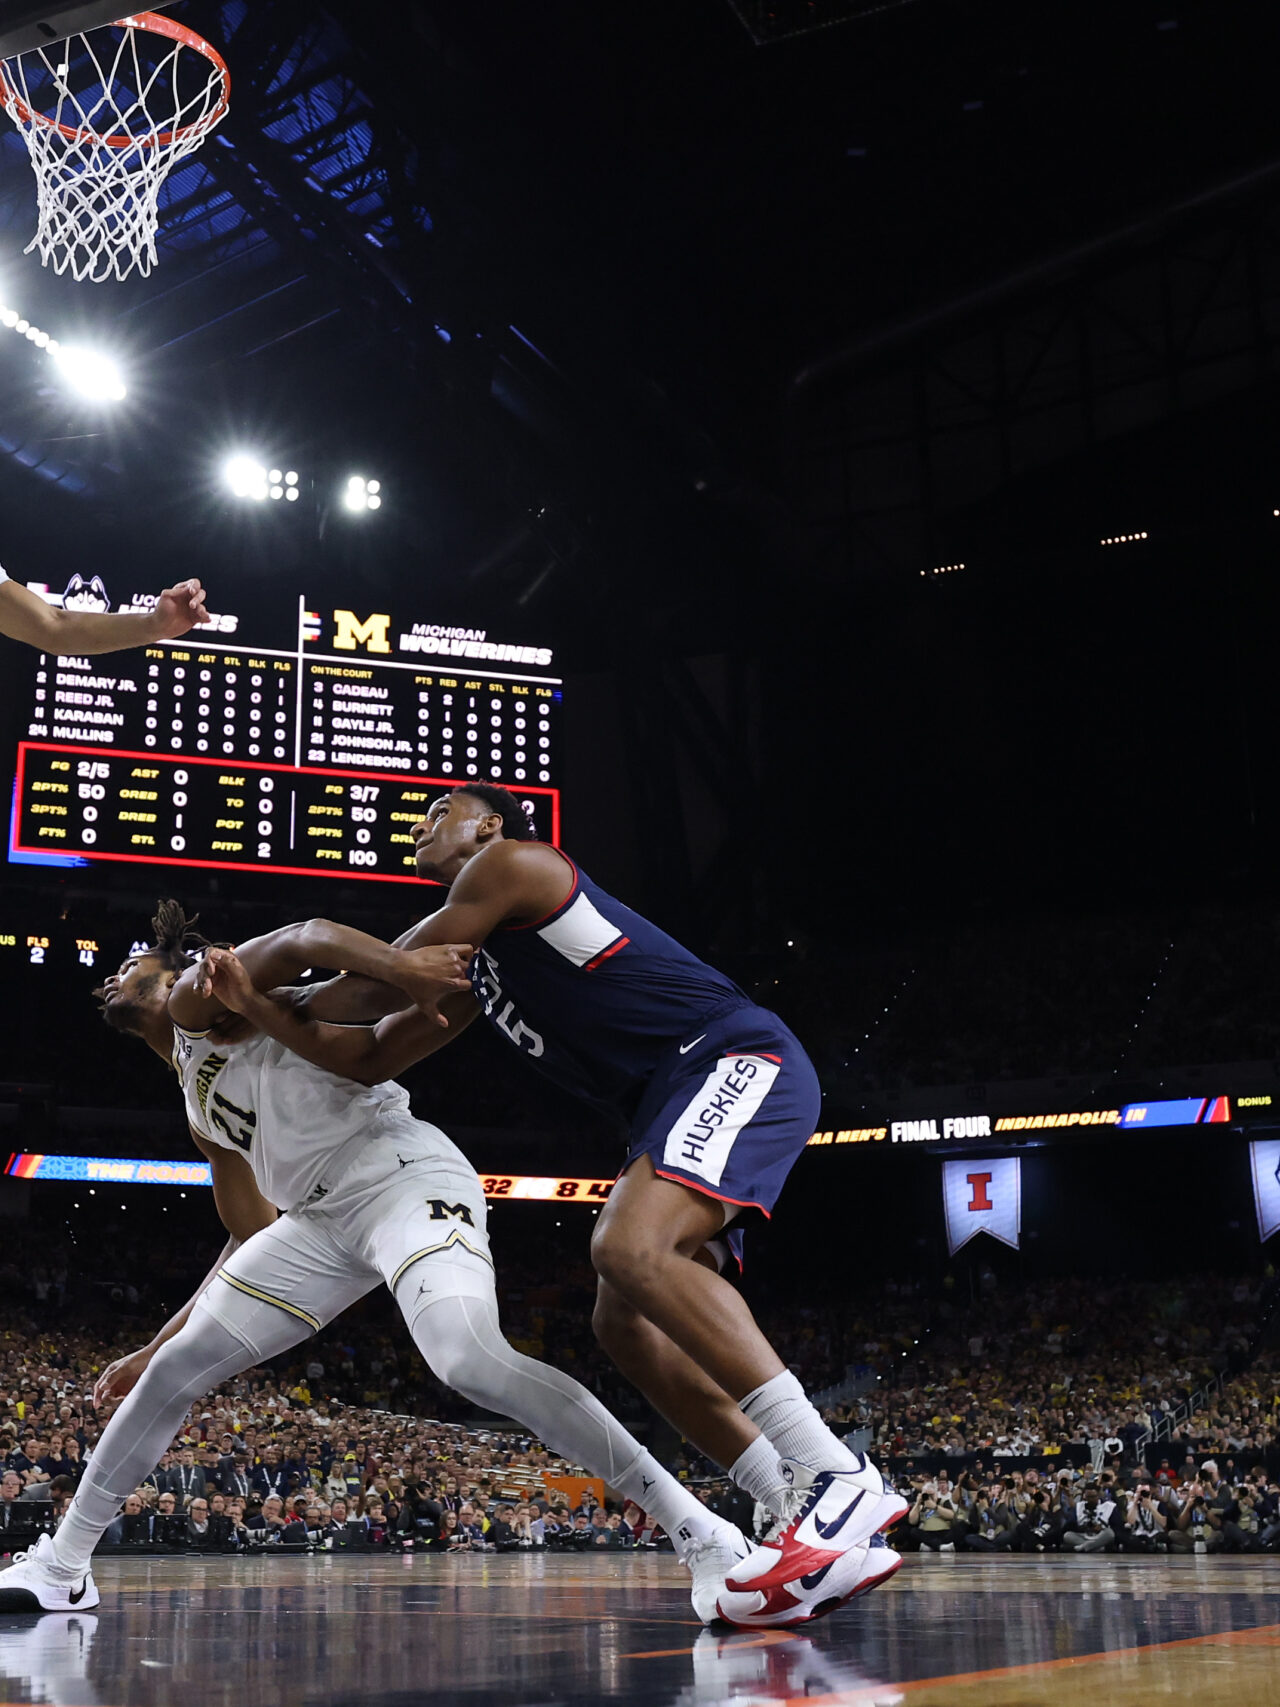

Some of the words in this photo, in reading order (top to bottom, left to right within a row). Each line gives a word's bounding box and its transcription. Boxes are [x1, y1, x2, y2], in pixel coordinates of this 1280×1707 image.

[333, 609, 392, 654] M
[412, 623, 486, 642] MICHIGAN
[146, 649, 163, 658] PTS
[172, 652, 190, 660] REB
[198, 655, 216, 663] AST
[224, 657, 240, 665] STL
[249, 659, 265, 668] BLK
[274, 662, 290, 671] FLS
[399, 634, 553, 666] WOLVERINES
[57, 656, 91, 670] BALL
[149, 665, 158, 676] 2
[174, 668, 185, 679] 0
[200, 670, 211, 681] 0
[279, 678, 284, 688] 1
[311, 665, 326, 675] ON
[325, 666, 342, 677] THE
[343, 667, 373, 679] COURT
[37, 672, 47, 683] 2
[56, 673, 116, 689] DEMARY
[118, 680, 137, 691] JR.
[148, 682, 158, 693] 0
[173, 685, 184, 696] 0
[199, 687, 210, 698] 0
[279, 695, 283, 705] 1
[314, 682, 323, 692] 3
[333, 684, 388, 699] CADEAU
[419, 692, 428, 703] 5
[443, 694, 452, 705] 2
[470, 697, 474, 707] 1
[415, 677, 432, 685] PTS
[440, 679, 457, 687] REB
[489, 684, 504, 692] STL
[512, 686, 528, 694] BLK
[536, 688, 552, 697] FLS
[36, 689, 45, 700] 5
[55, 691, 93, 705] REED
[147, 700, 157, 711] 2
[175, 703, 180, 713] 1
[199, 705, 209, 716] 0
[275, 712, 286, 723] 0
[313, 699, 323, 709] 4
[333, 701, 394, 716] BURNETT
[418, 709, 429, 720] 0
[445, 711, 450, 721] 1
[467, 713, 477, 724] 0
[35, 707, 44, 718] 11
[54, 708, 123, 725] KARABAN
[146, 717, 157, 728] 0
[172, 720, 183, 731] 0
[198, 722, 209, 733] 0
[274, 729, 285, 740] 0
[313, 716, 322, 726] 11
[332, 717, 374, 731] GAYLE
[375, 722, 394, 733] JR.
[418, 726, 428, 736] 0
[442, 728, 453, 739] 0
[467, 730, 477, 741] 0
[29, 724, 47, 736] 24
[53, 726, 113, 742] MULLINS
[145, 735, 156, 746] 0
[171, 737, 182, 748] 0
[197, 739, 208, 751] 0
[274, 746, 285, 757] 0
[311, 733, 324, 744] 21
[331, 735, 393, 750] JOHNSON
[394, 741, 413, 752] JR.
[418, 743, 428, 753] 4
[443, 745, 452, 756] 2
[467, 747, 477, 758] 0
[308, 749, 326, 761] 23
[331, 752, 411, 769] LENDEBORG
[418, 759, 428, 770] 0
[442, 762, 452, 773] 0
[467, 764, 477, 775] 0
[51, 761, 70, 770] FG
[77, 762, 109, 779] 2/5
[131, 769, 159, 778] AST
[174, 770, 188, 785] 0
[219, 776, 245, 786] BLK
[259, 778, 273, 792] 0
[32, 782, 68, 793] 2PT%
[79, 784, 105, 799] 50
[120, 789, 157, 800] OREB
[173, 792, 187, 806] 0
[227, 799, 243, 807] TO
[259, 799, 273, 814] 0
[325, 785, 343, 794] FG
[350, 785, 379, 802] 3/7
[401, 792, 427, 801] AST
[31, 804, 67, 815] 3PT%
[83, 806, 97, 821] 0
[119, 812, 156, 822] DREB
[176, 814, 182, 828] 1
[216, 820, 243, 829] POT
[258, 821, 272, 835] 0
[308, 806, 342, 816] 2PT%
[351, 807, 377, 822] 50
[39, 827, 65, 837] FT%
[82, 828, 96, 844] 0
[131, 835, 155, 844] STL
[171, 836, 185, 850] 0
[212, 841, 242, 851] PITP
[258, 843, 271, 857] 2
[308, 827, 342, 837] 3PT%
[357, 829, 370, 843] 0
[316, 850, 342, 859] FT%
[349, 850, 377, 866] 100
[27, 936, 50, 949] FLS
[30, 946, 45, 964] 2
[76, 939, 99, 952] TOL
[79, 950, 95, 967] 4
[496, 1000, 544, 1057] 5
[681, 1059, 758, 1163] HUSKIES
[1237, 1096, 1271, 1107] BONUS
[210, 1091, 257, 1152] 21
[835, 1127, 887, 1144] MEN'S
[891, 1119, 941, 1143] FINAL
[943, 1115, 992, 1139] FOUR
[994, 1110, 1123, 1132] INDIANAPOLIS,
[1124, 1107, 1147, 1122] IN
[87, 1162, 135, 1180] THE
[136, 1164, 208, 1182] ROAD
[483, 1178, 512, 1195] 32
[556, 1181, 579, 1198] 8
[966, 1172, 993, 1212] I
[426, 1199, 476, 1228] M
